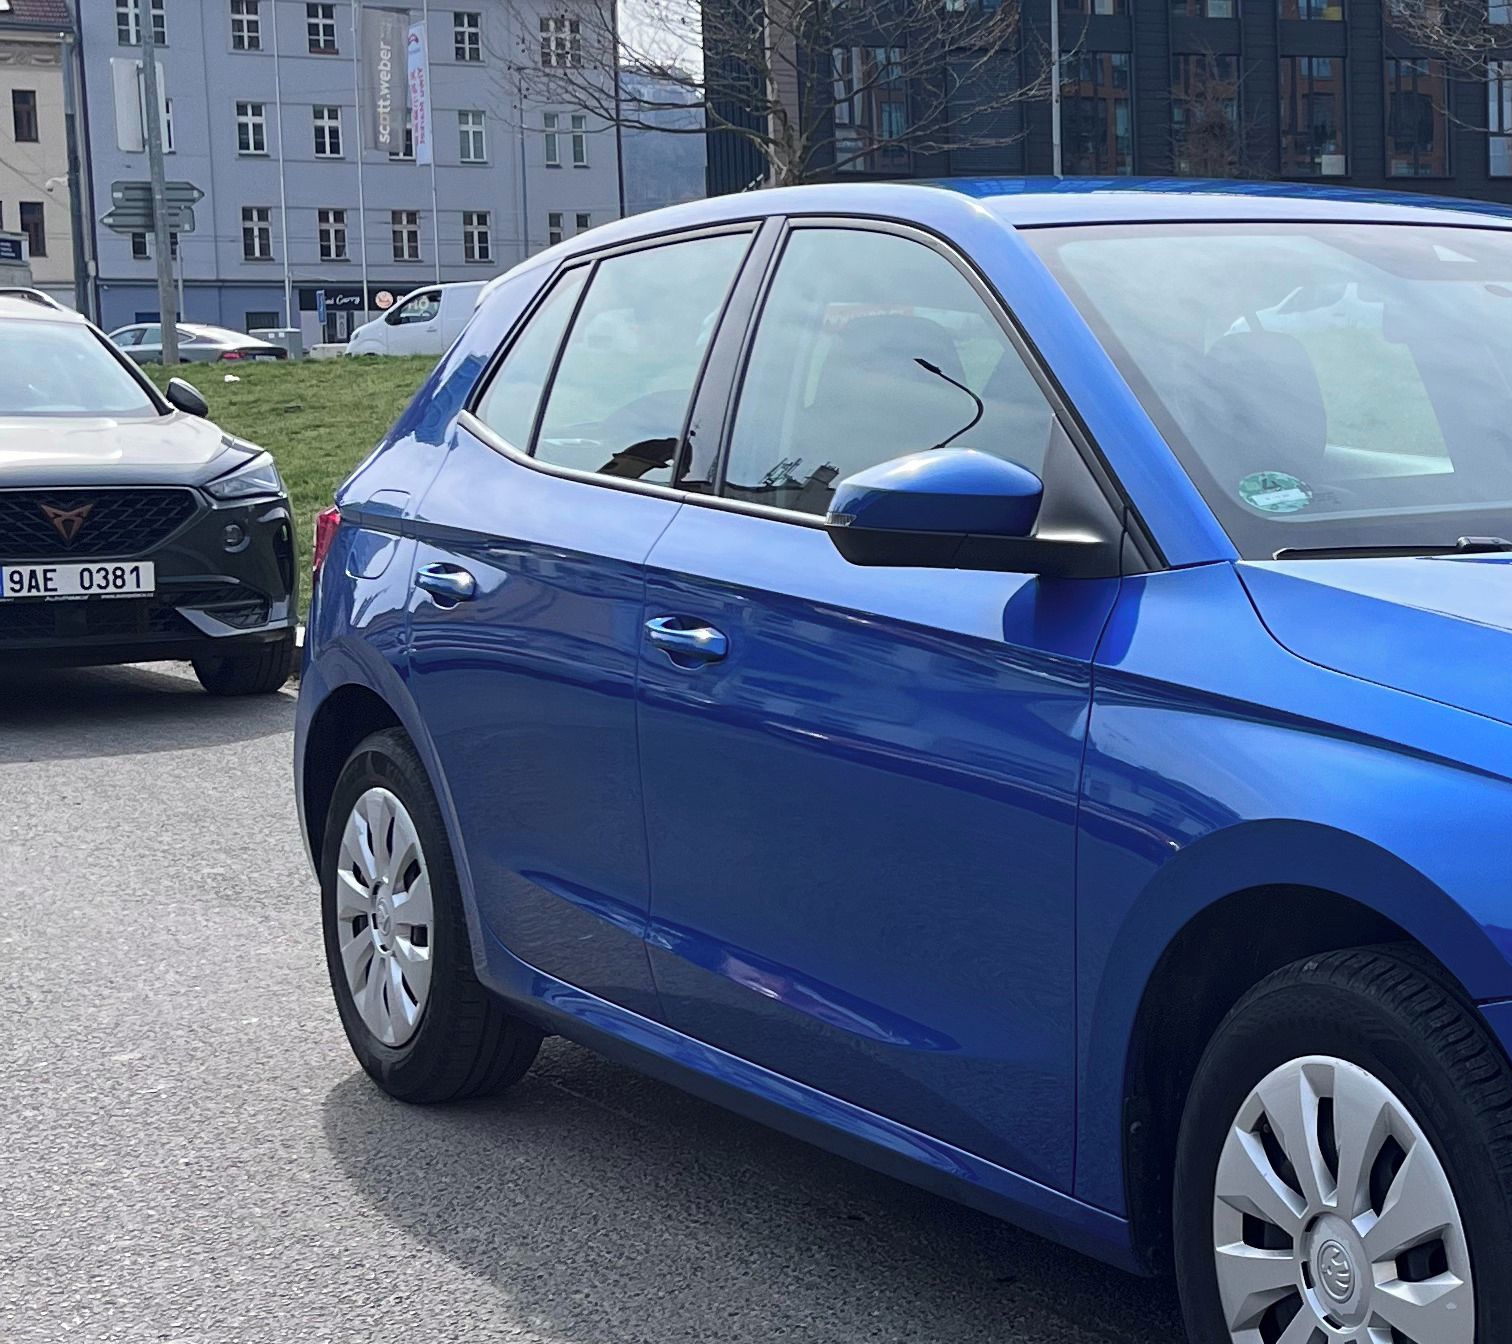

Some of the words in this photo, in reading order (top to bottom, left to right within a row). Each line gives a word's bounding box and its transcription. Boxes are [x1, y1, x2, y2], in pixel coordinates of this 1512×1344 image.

[377, 43, 392, 144] scott.weber
[9, 568, 58, 594] 9AE
[79, 565, 142, 591] 0381
